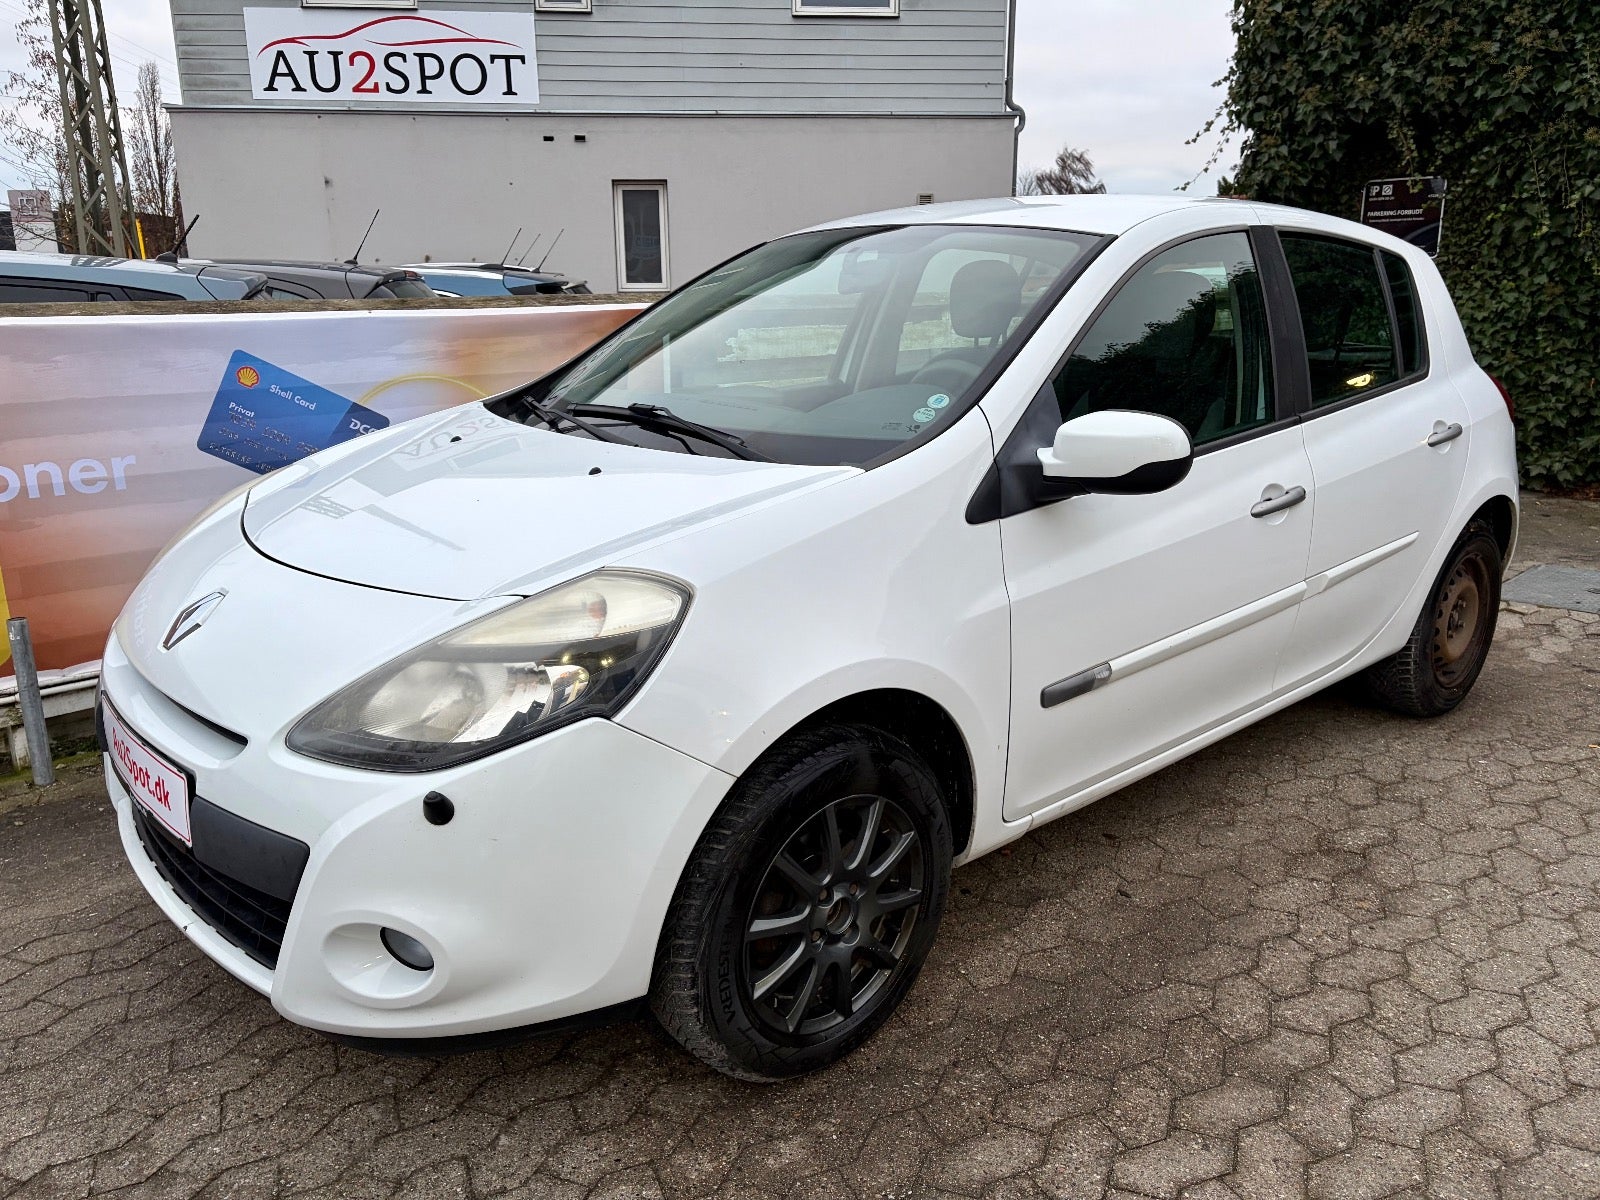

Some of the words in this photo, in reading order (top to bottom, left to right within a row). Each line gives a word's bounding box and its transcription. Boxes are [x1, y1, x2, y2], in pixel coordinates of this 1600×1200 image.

[263, 50, 526, 96] AU2SPOT
[229, 401, 255, 418] Privat
[269, 384, 293, 400] Shell
[294, 395, 317, 411] Card
[112, 727, 172, 812] Au2Spot.dk
